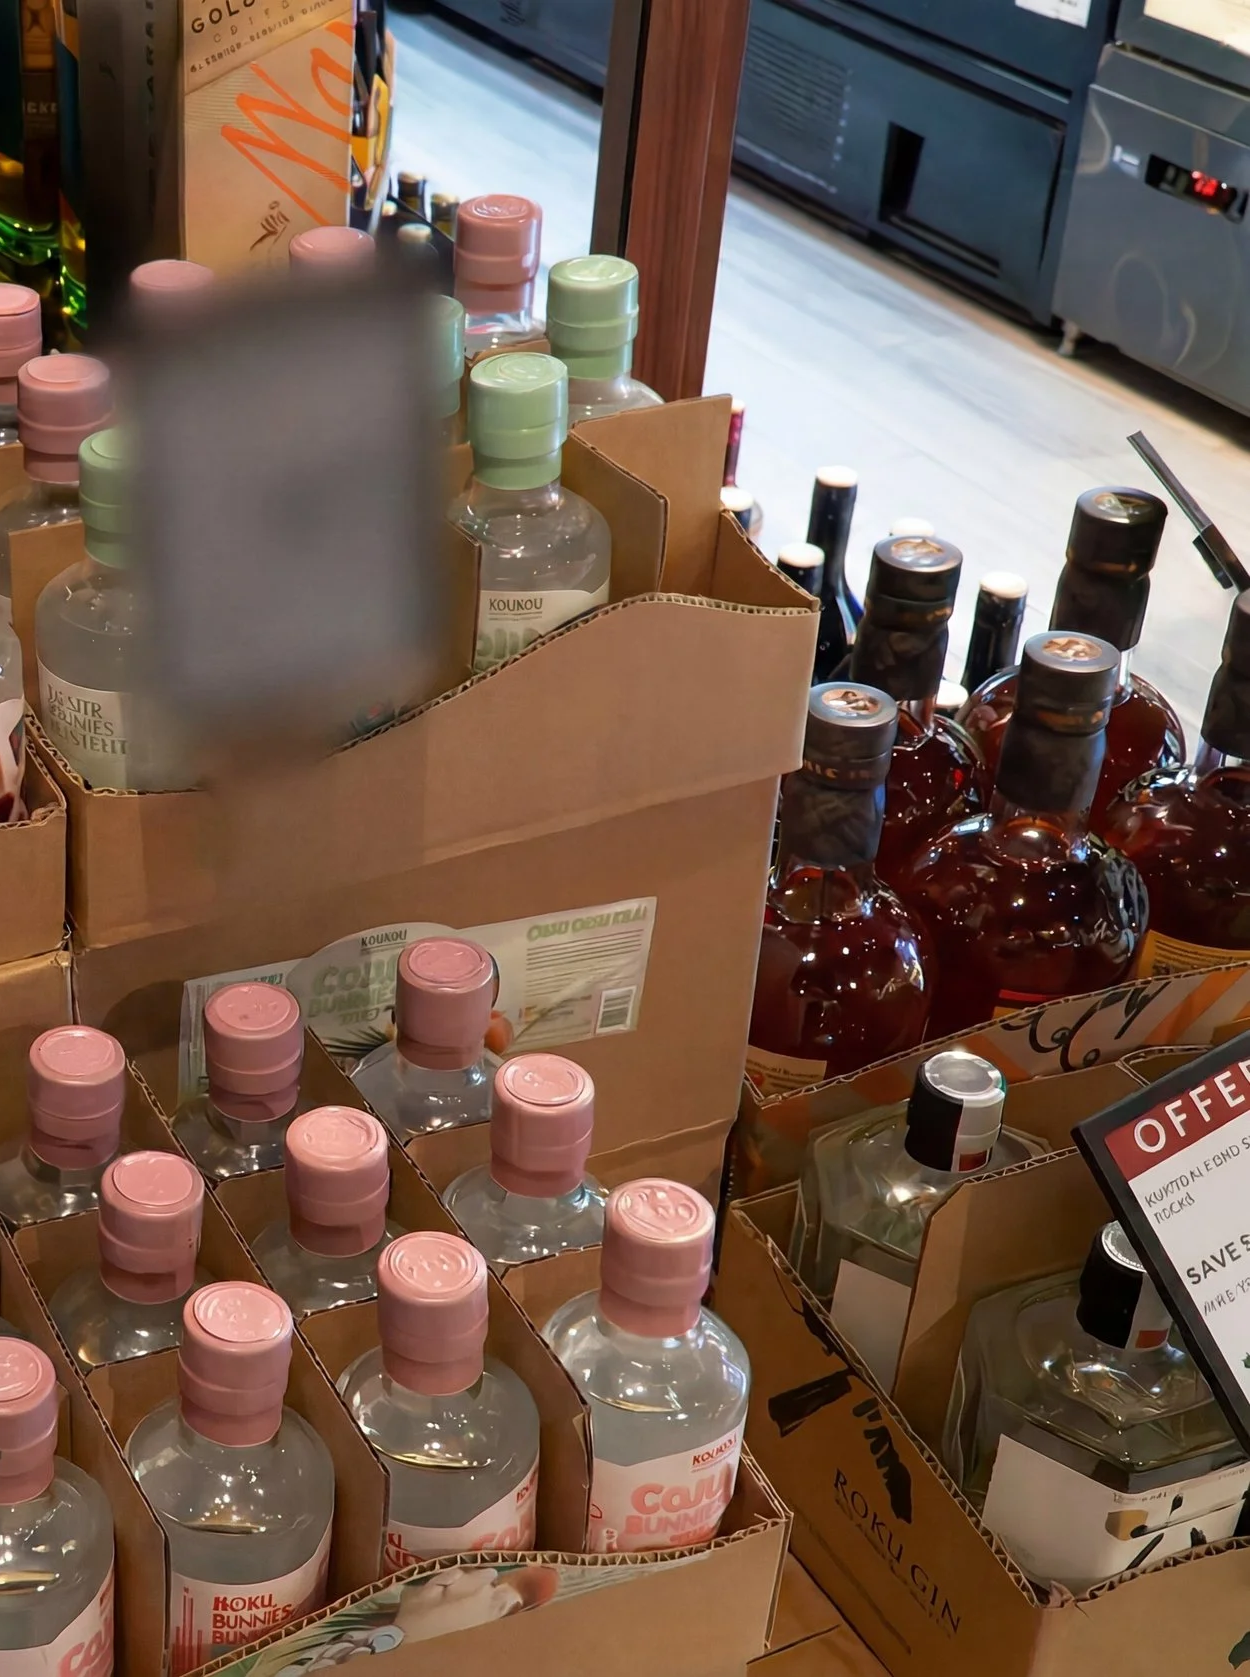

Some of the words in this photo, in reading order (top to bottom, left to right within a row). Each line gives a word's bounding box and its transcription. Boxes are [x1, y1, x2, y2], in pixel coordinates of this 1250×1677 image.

[1186, 1241, 1242, 1286] SAVE
[834, 1468, 904, 1563] ROKU
[910, 1564, 962, 1634] GIN
